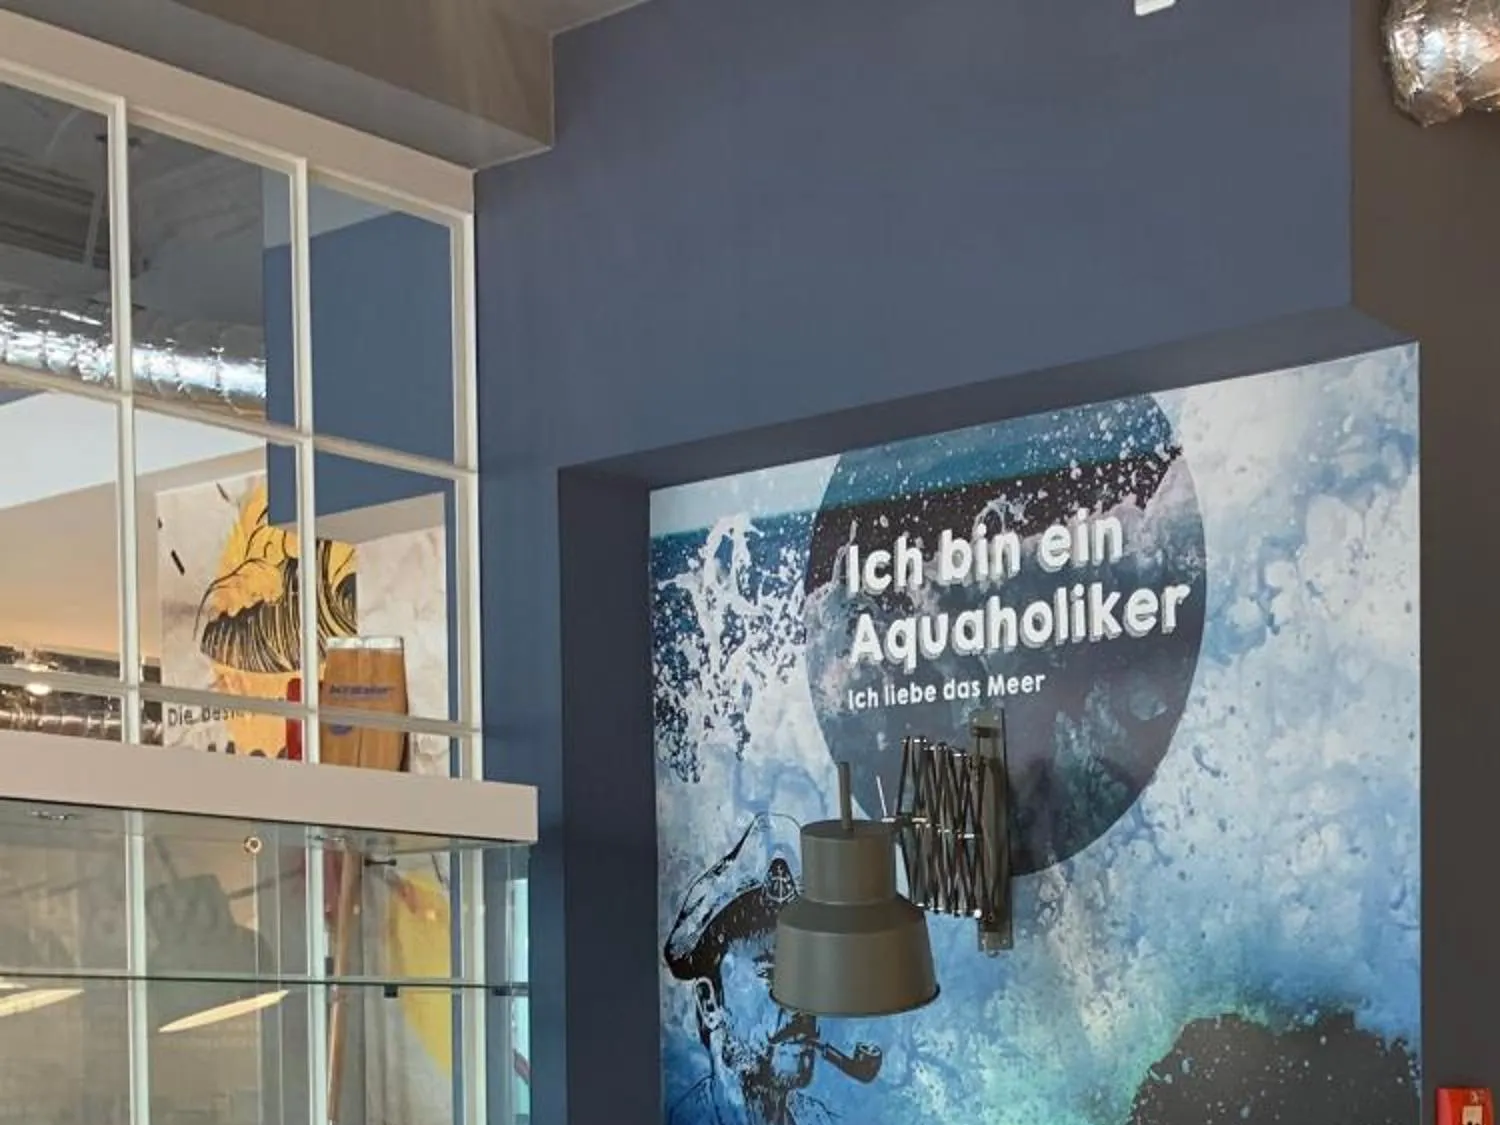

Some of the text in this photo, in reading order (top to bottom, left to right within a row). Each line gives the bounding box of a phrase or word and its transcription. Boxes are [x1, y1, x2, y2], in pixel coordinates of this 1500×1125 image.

[847, 507, 1123, 598] Ich bin ein
[849, 582, 1191, 674] Aquaholiker
[848, 673, 1046, 710] Ich liebe das Meer
